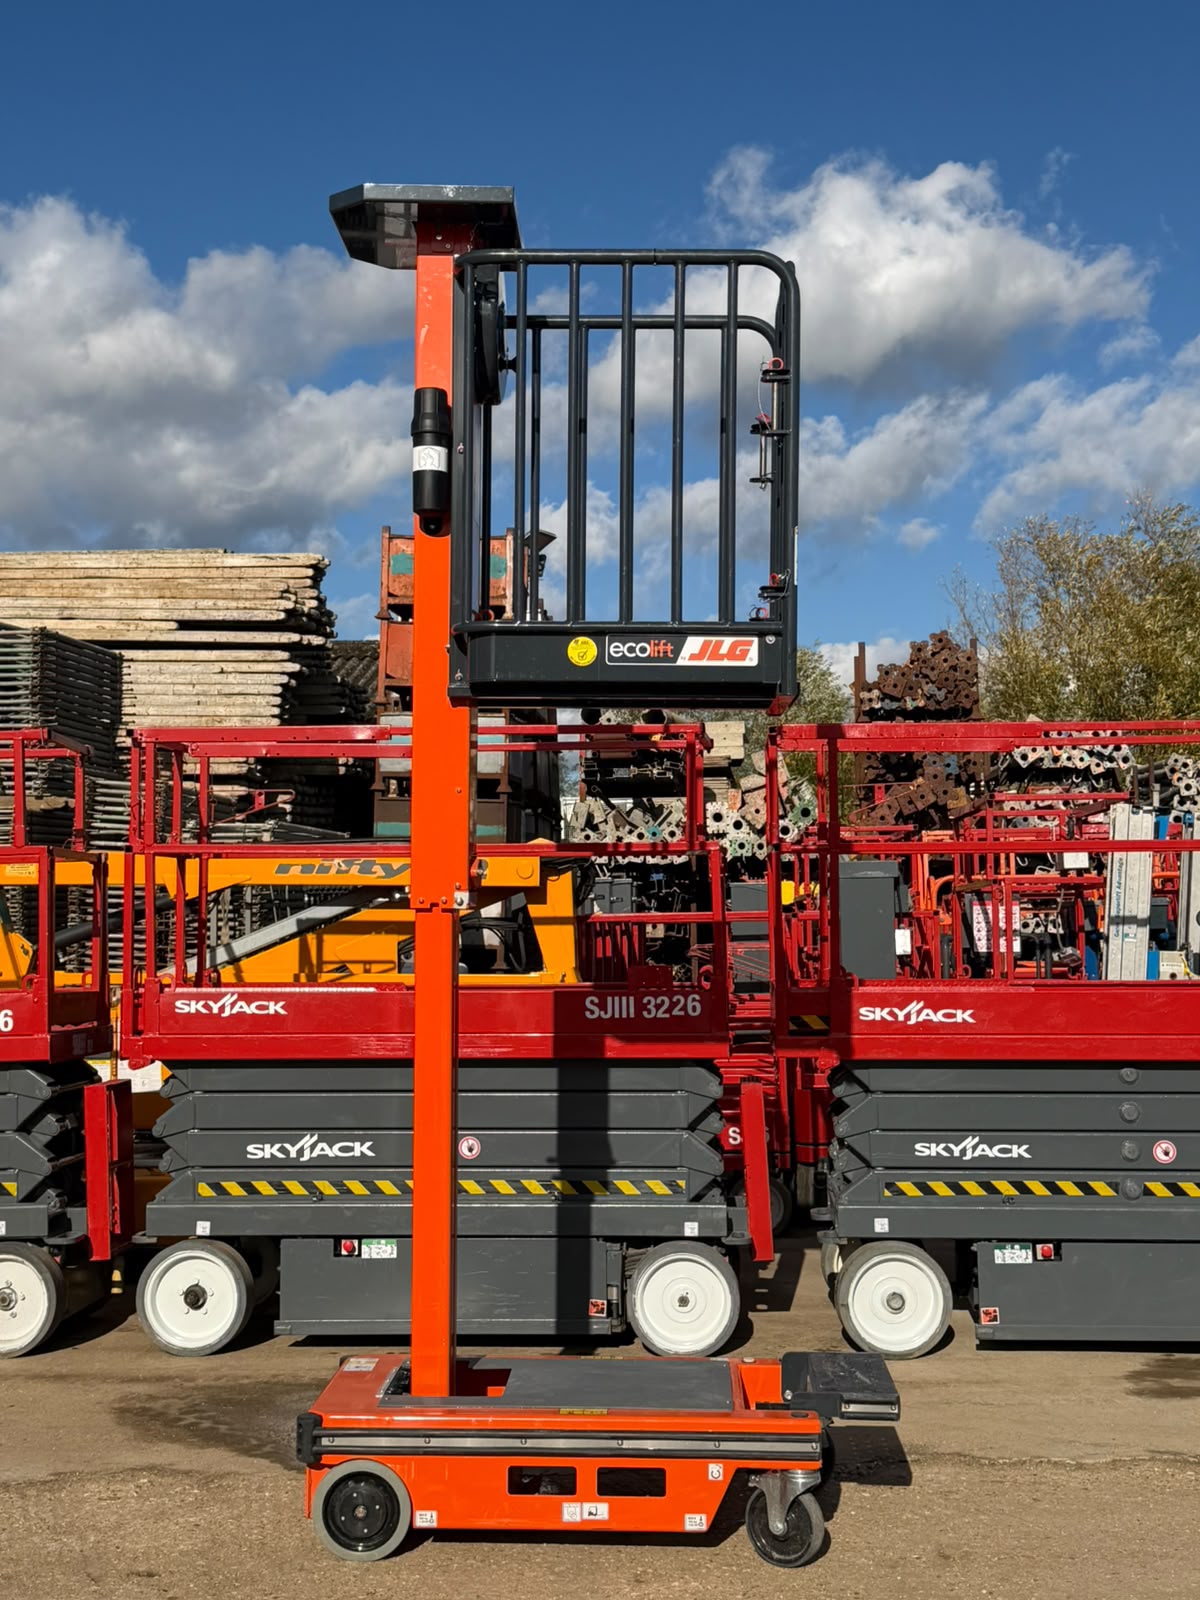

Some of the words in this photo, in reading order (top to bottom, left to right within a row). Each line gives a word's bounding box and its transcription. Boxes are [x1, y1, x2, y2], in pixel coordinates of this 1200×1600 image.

[609, 639, 674, 658] ecolift
[687, 639, 754, 661] JLG
[274, 858, 411, 879] nifty
[174, 992, 288, 1018] SKYJACK
[641, 993, 702, 1019] 3226
[858, 999, 977, 1025] SKYJACK
[246, 1133, 376, 1161] SKYJACK
[914, 1135, 1033, 1161] SKYJACK
